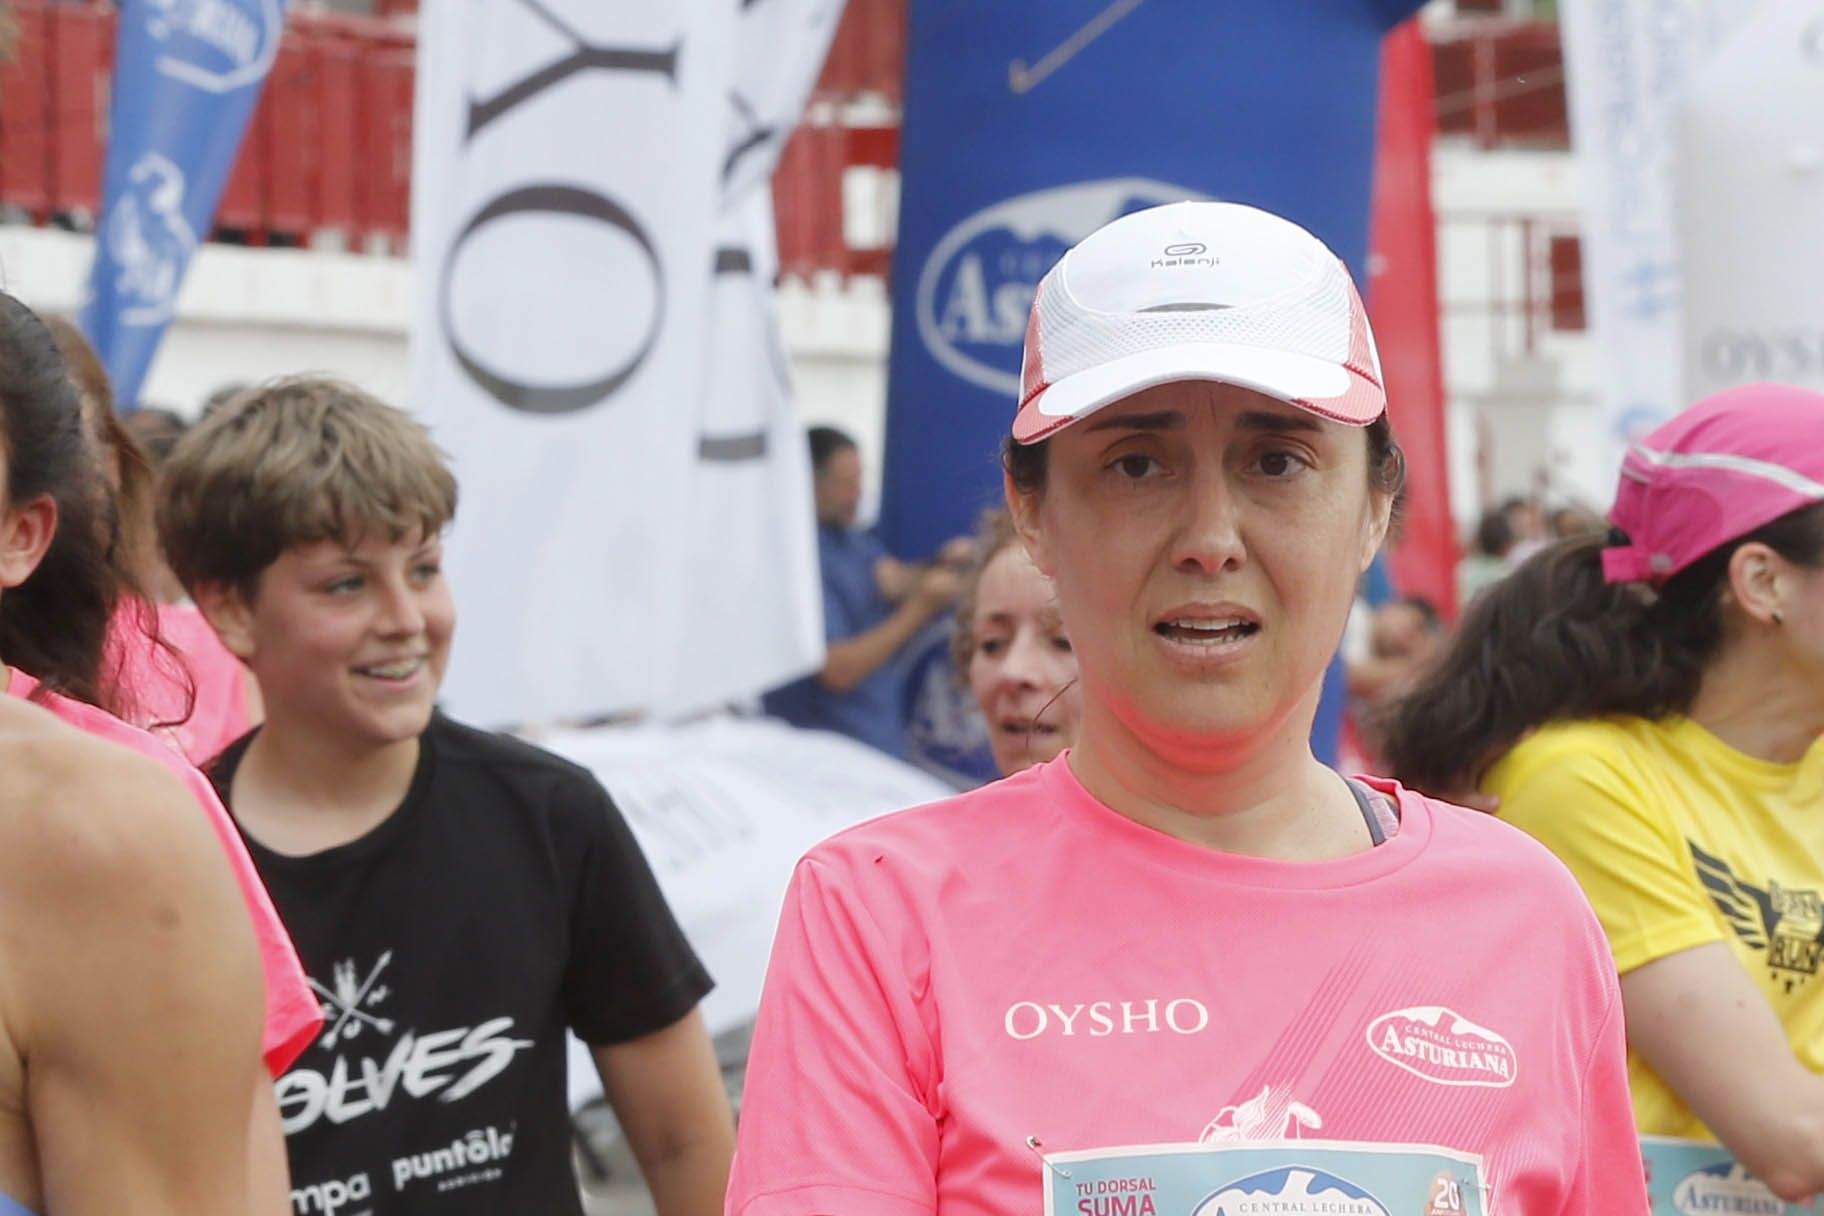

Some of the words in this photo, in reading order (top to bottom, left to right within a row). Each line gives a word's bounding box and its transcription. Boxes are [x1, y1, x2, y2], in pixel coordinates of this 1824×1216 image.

[1004, 998, 1209, 1040] OYSHO
[1381, 1023, 1510, 1079] ASTURIANA
[1076, 1182, 1094, 1197] TU
[1099, 1177, 1157, 1193] DORSAL
[1434, 1177, 1461, 1210] 20
[1239, 1202, 1306, 1213] CENTRAL
[1312, 1203, 1373, 1215] LECHERA
